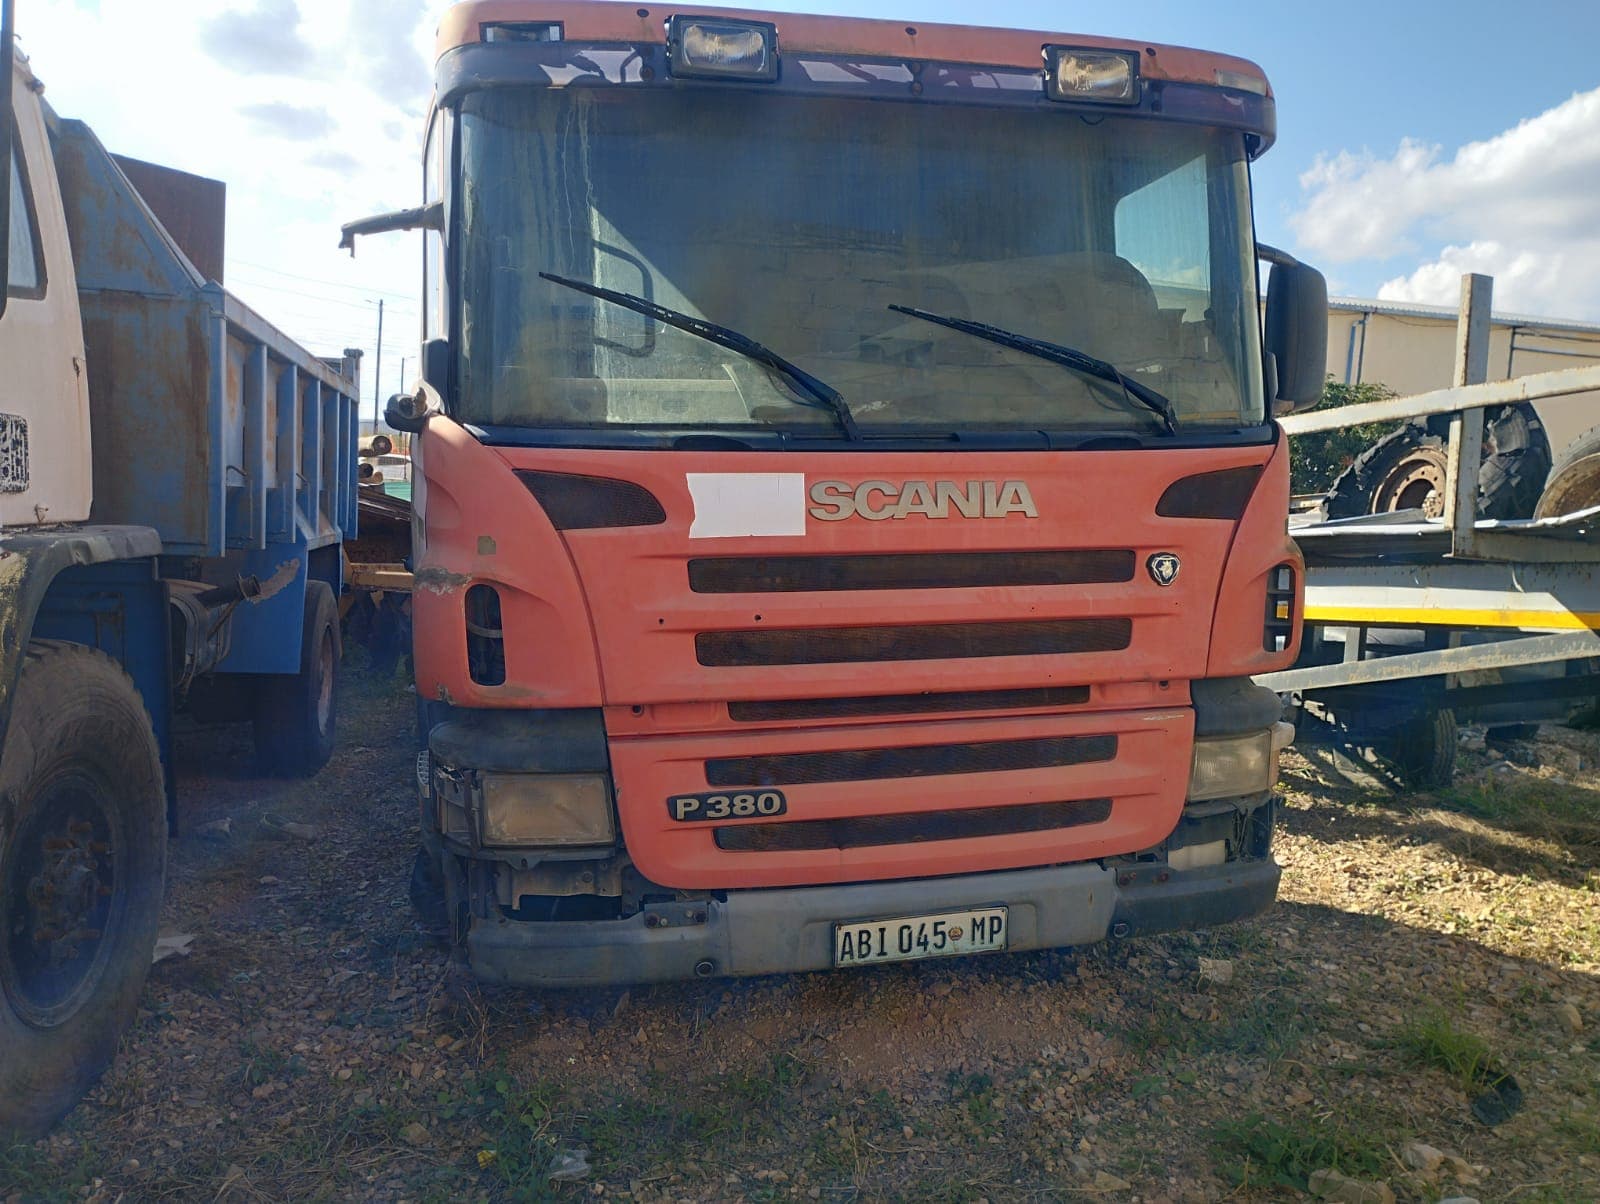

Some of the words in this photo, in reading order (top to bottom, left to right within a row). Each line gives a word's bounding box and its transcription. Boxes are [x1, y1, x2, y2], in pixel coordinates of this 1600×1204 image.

[809, 480, 1039, 521] SCANIA
[676, 798, 700, 820] P
[706, 793, 781, 818] 380
[840, 928, 888, 961] ABI
[898, 921, 947, 953] 045
[971, 916, 1003, 945] MP
